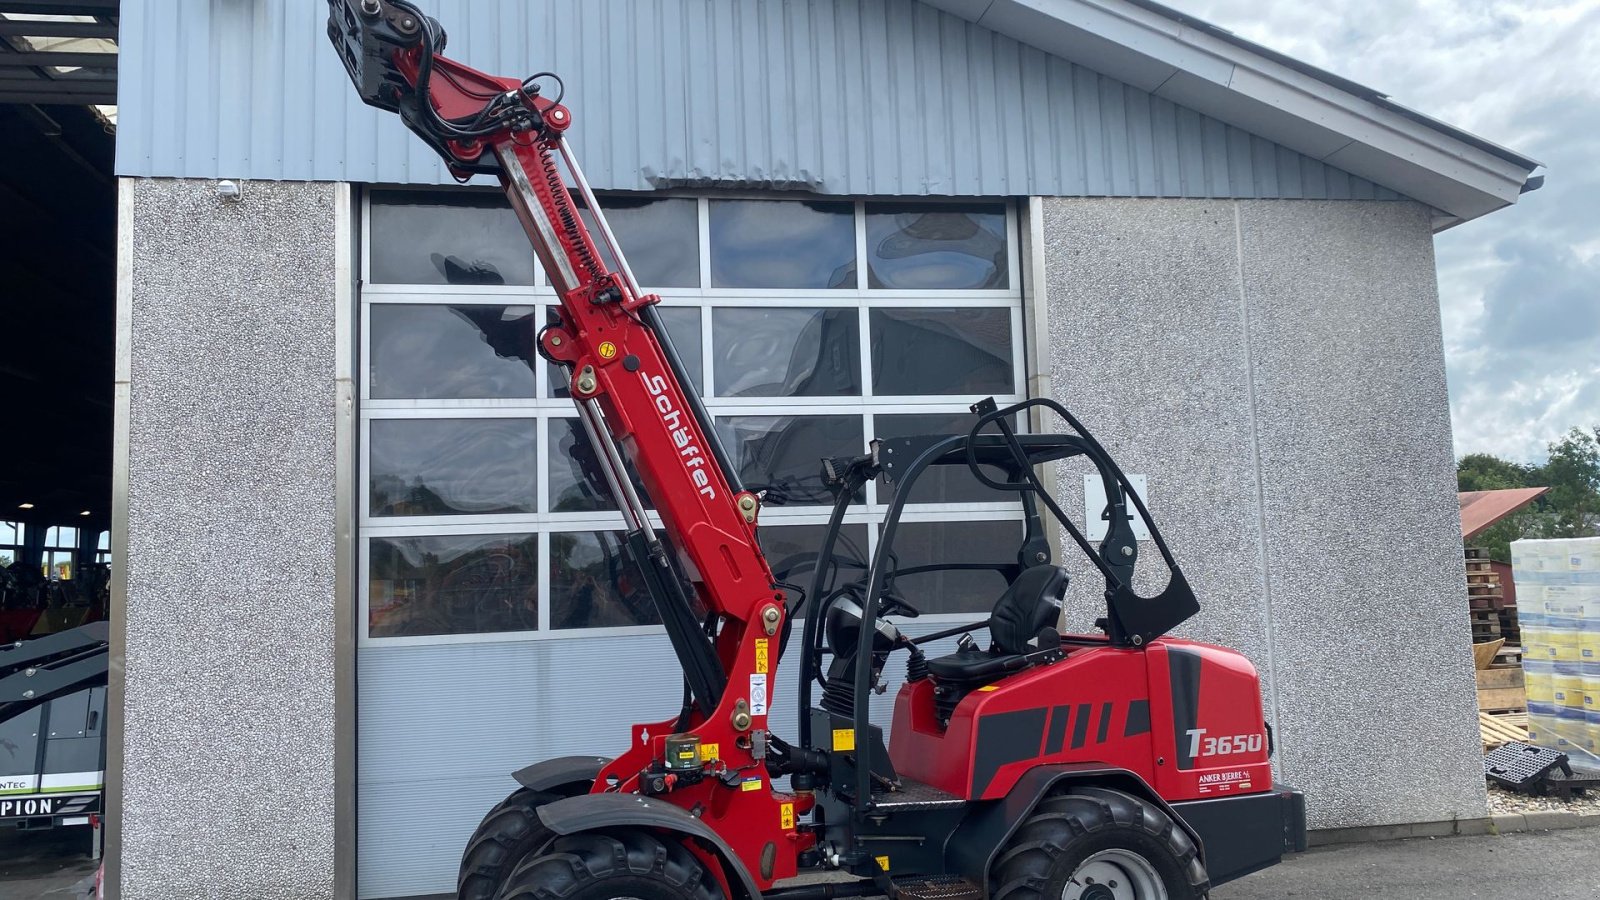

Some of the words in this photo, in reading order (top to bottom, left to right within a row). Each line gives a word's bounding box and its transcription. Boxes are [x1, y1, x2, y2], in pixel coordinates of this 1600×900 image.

[642, 371, 716, 500] Schäffer
[1185, 728, 1262, 758] T3650
[1199, 773, 1221, 783] ANKER
